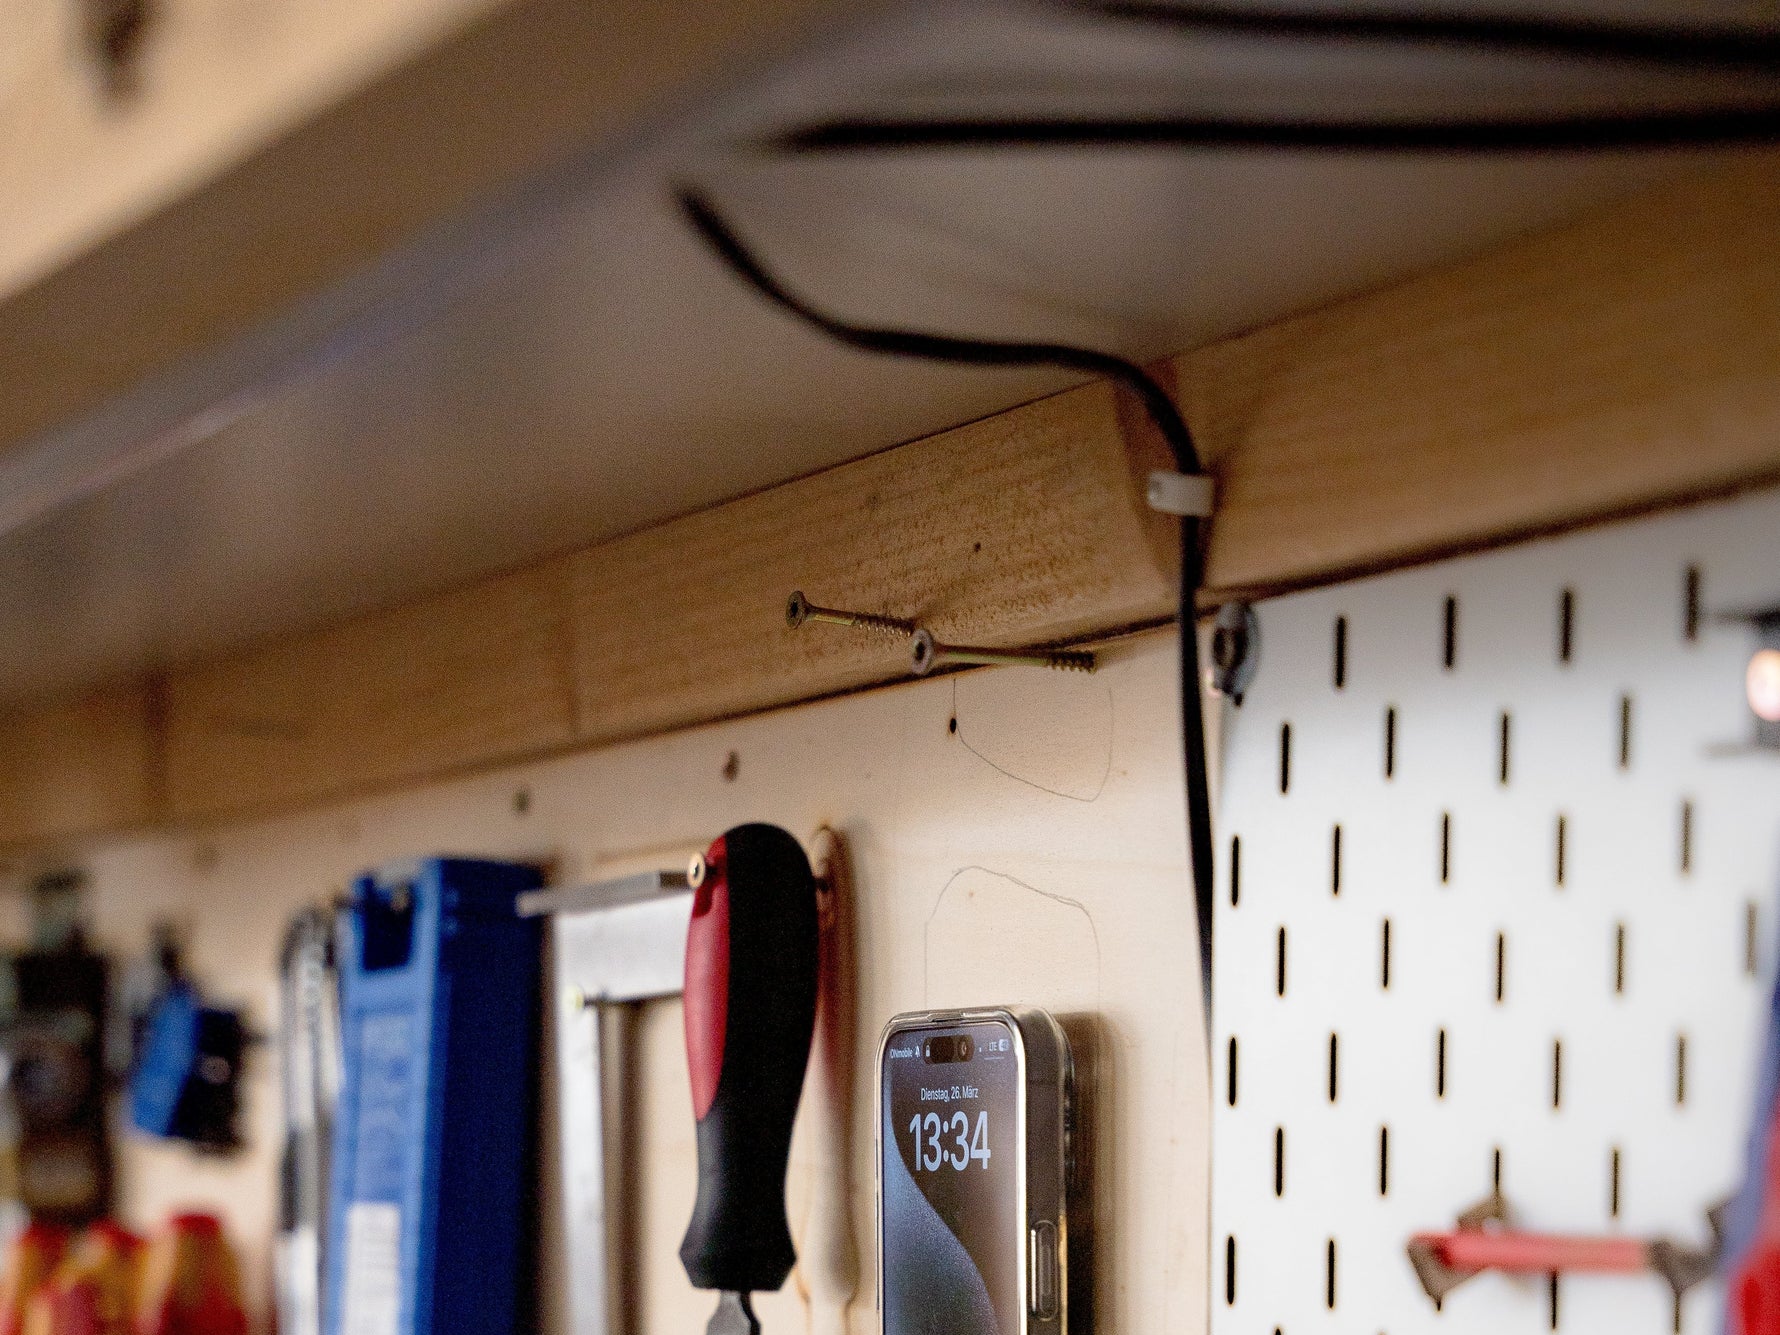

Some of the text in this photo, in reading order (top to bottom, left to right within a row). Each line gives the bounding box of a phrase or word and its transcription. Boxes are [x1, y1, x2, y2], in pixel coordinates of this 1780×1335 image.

[920, 1085, 979, 1102] Dienstag, 26. März
[909, 1110, 991, 1172] 13:34
